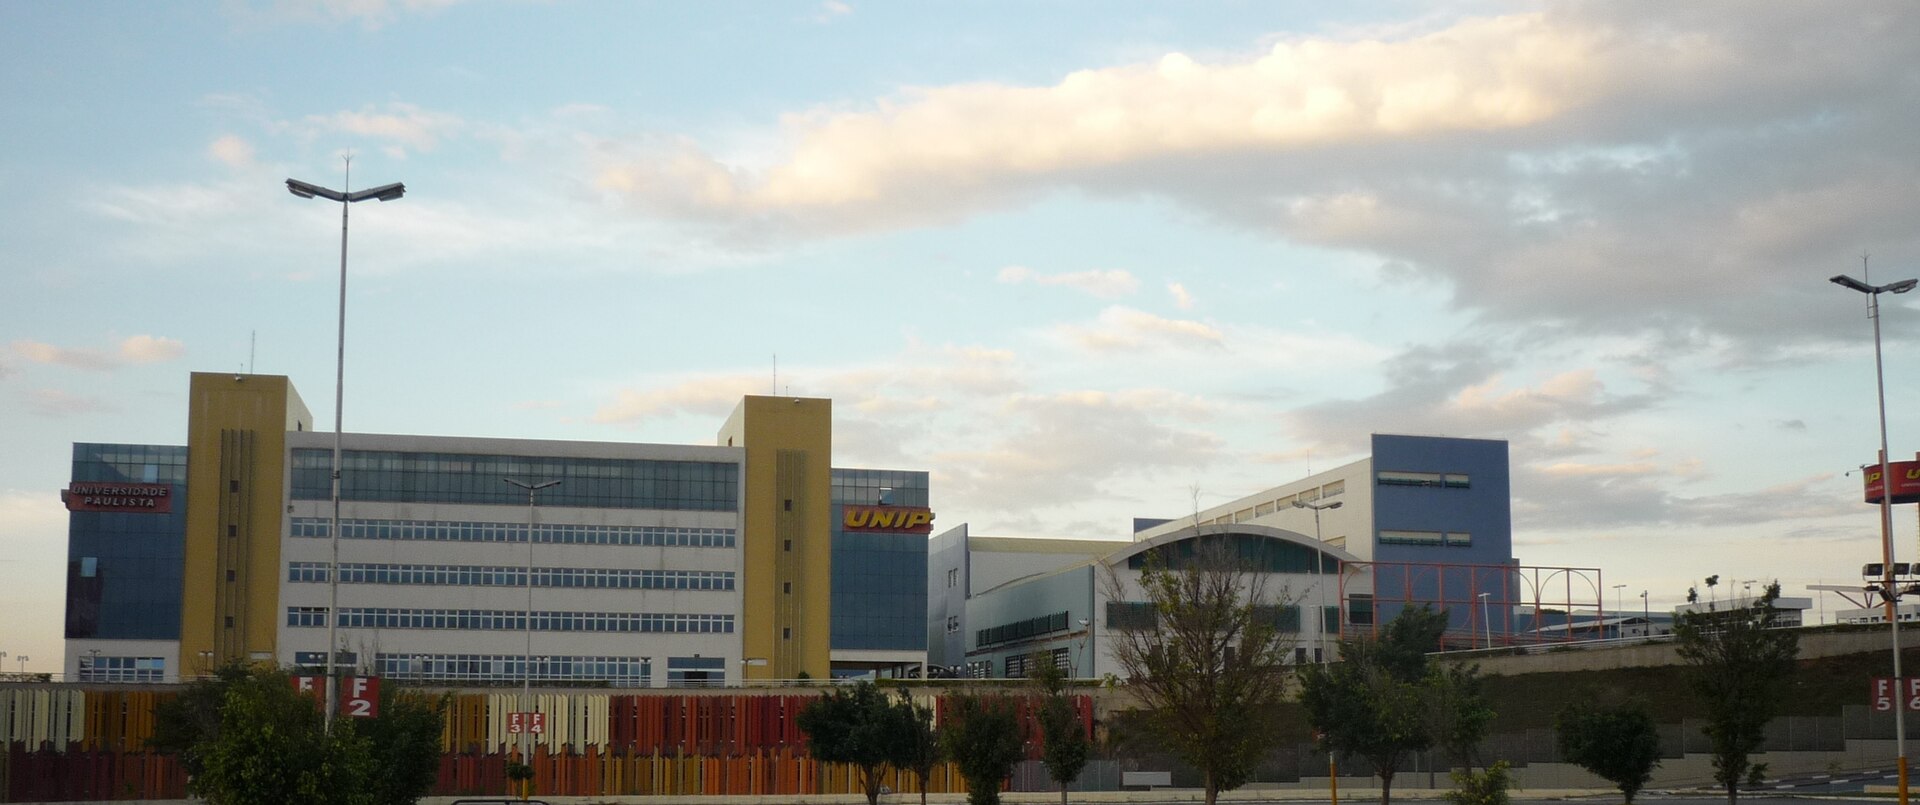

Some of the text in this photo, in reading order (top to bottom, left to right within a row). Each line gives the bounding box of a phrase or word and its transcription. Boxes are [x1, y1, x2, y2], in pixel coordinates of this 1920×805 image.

[73, 486, 167, 497] UNIVERSIDADE
[84, 496, 155, 507] PAULISTA
[846, 510, 931, 529] UNIP
[353, 678, 368, 698] F
[1878, 680, 1888, 696] F
[1911, 679, 1920, 696] F
[349, 700, 371, 716] 2
[1877, 697, 1890, 710] 5
[512, 713, 520, 724] F
[533, 713, 541, 724] F
[510, 724, 521, 733] 3
[530, 724, 542, 733] 4
